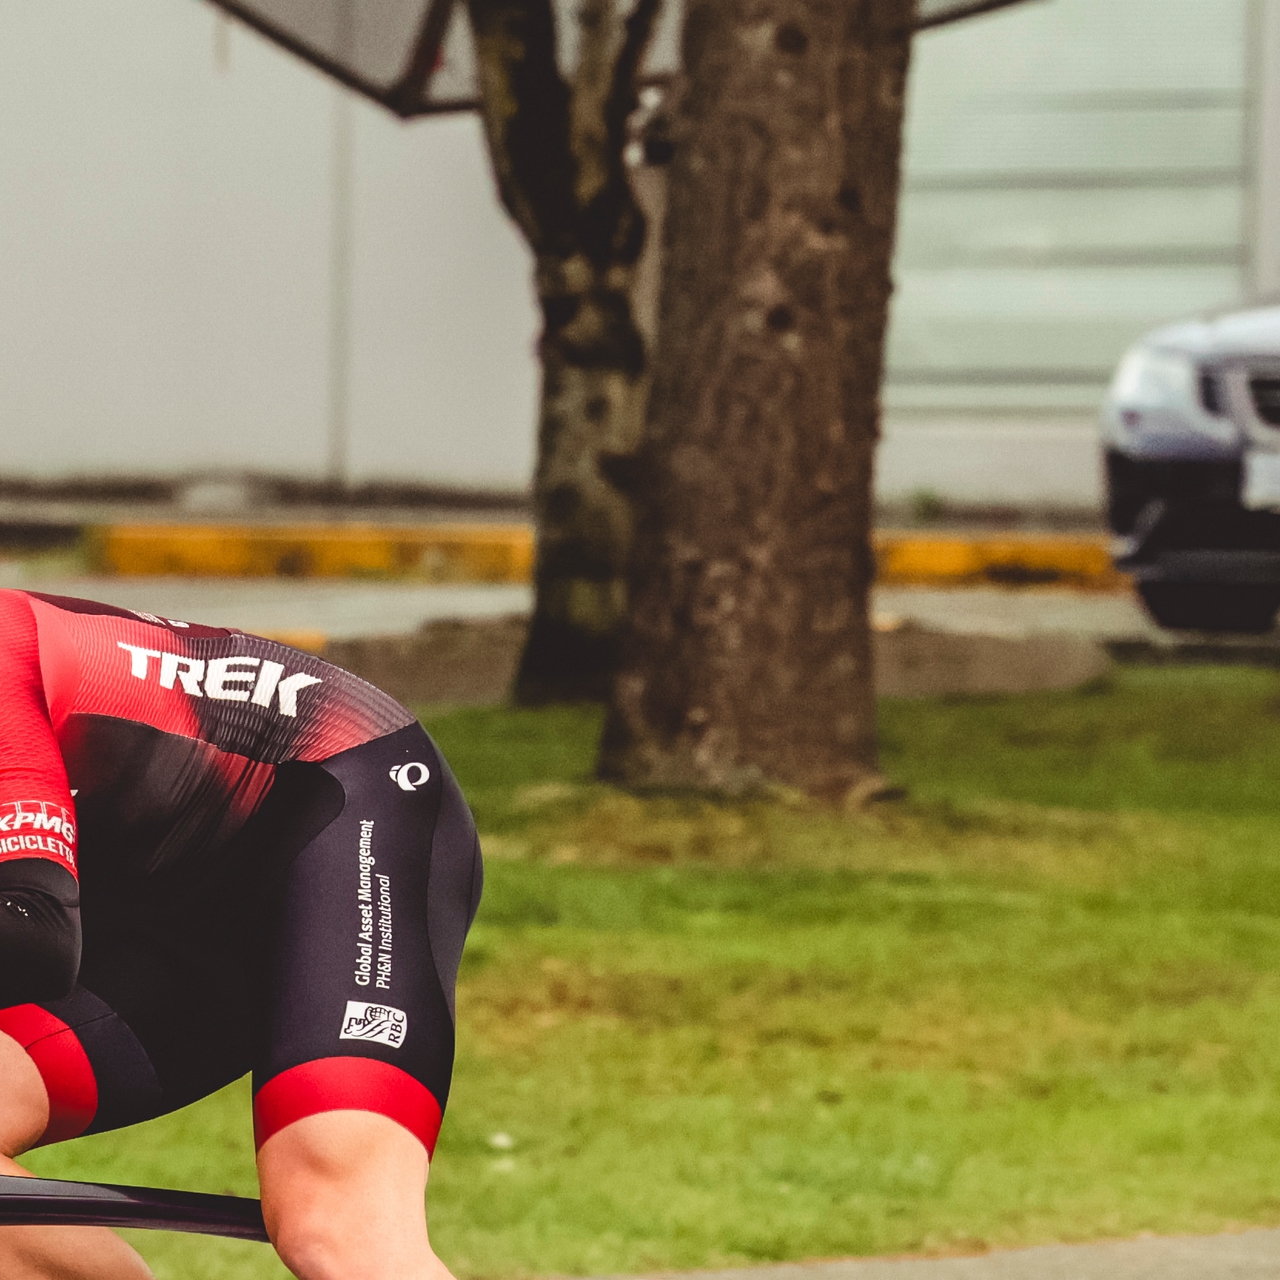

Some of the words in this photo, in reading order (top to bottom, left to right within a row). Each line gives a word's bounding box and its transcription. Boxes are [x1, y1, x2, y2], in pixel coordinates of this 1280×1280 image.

[117, 641, 323, 718] TREK
[357, 819, 375, 901] Management
[359, 903, 373, 936] Asset
[376, 873, 392, 951] Institutional
[355, 938, 372, 987] Global
[376, 954, 392, 990] PH&N
[388, 1011, 405, 1044] RBC
